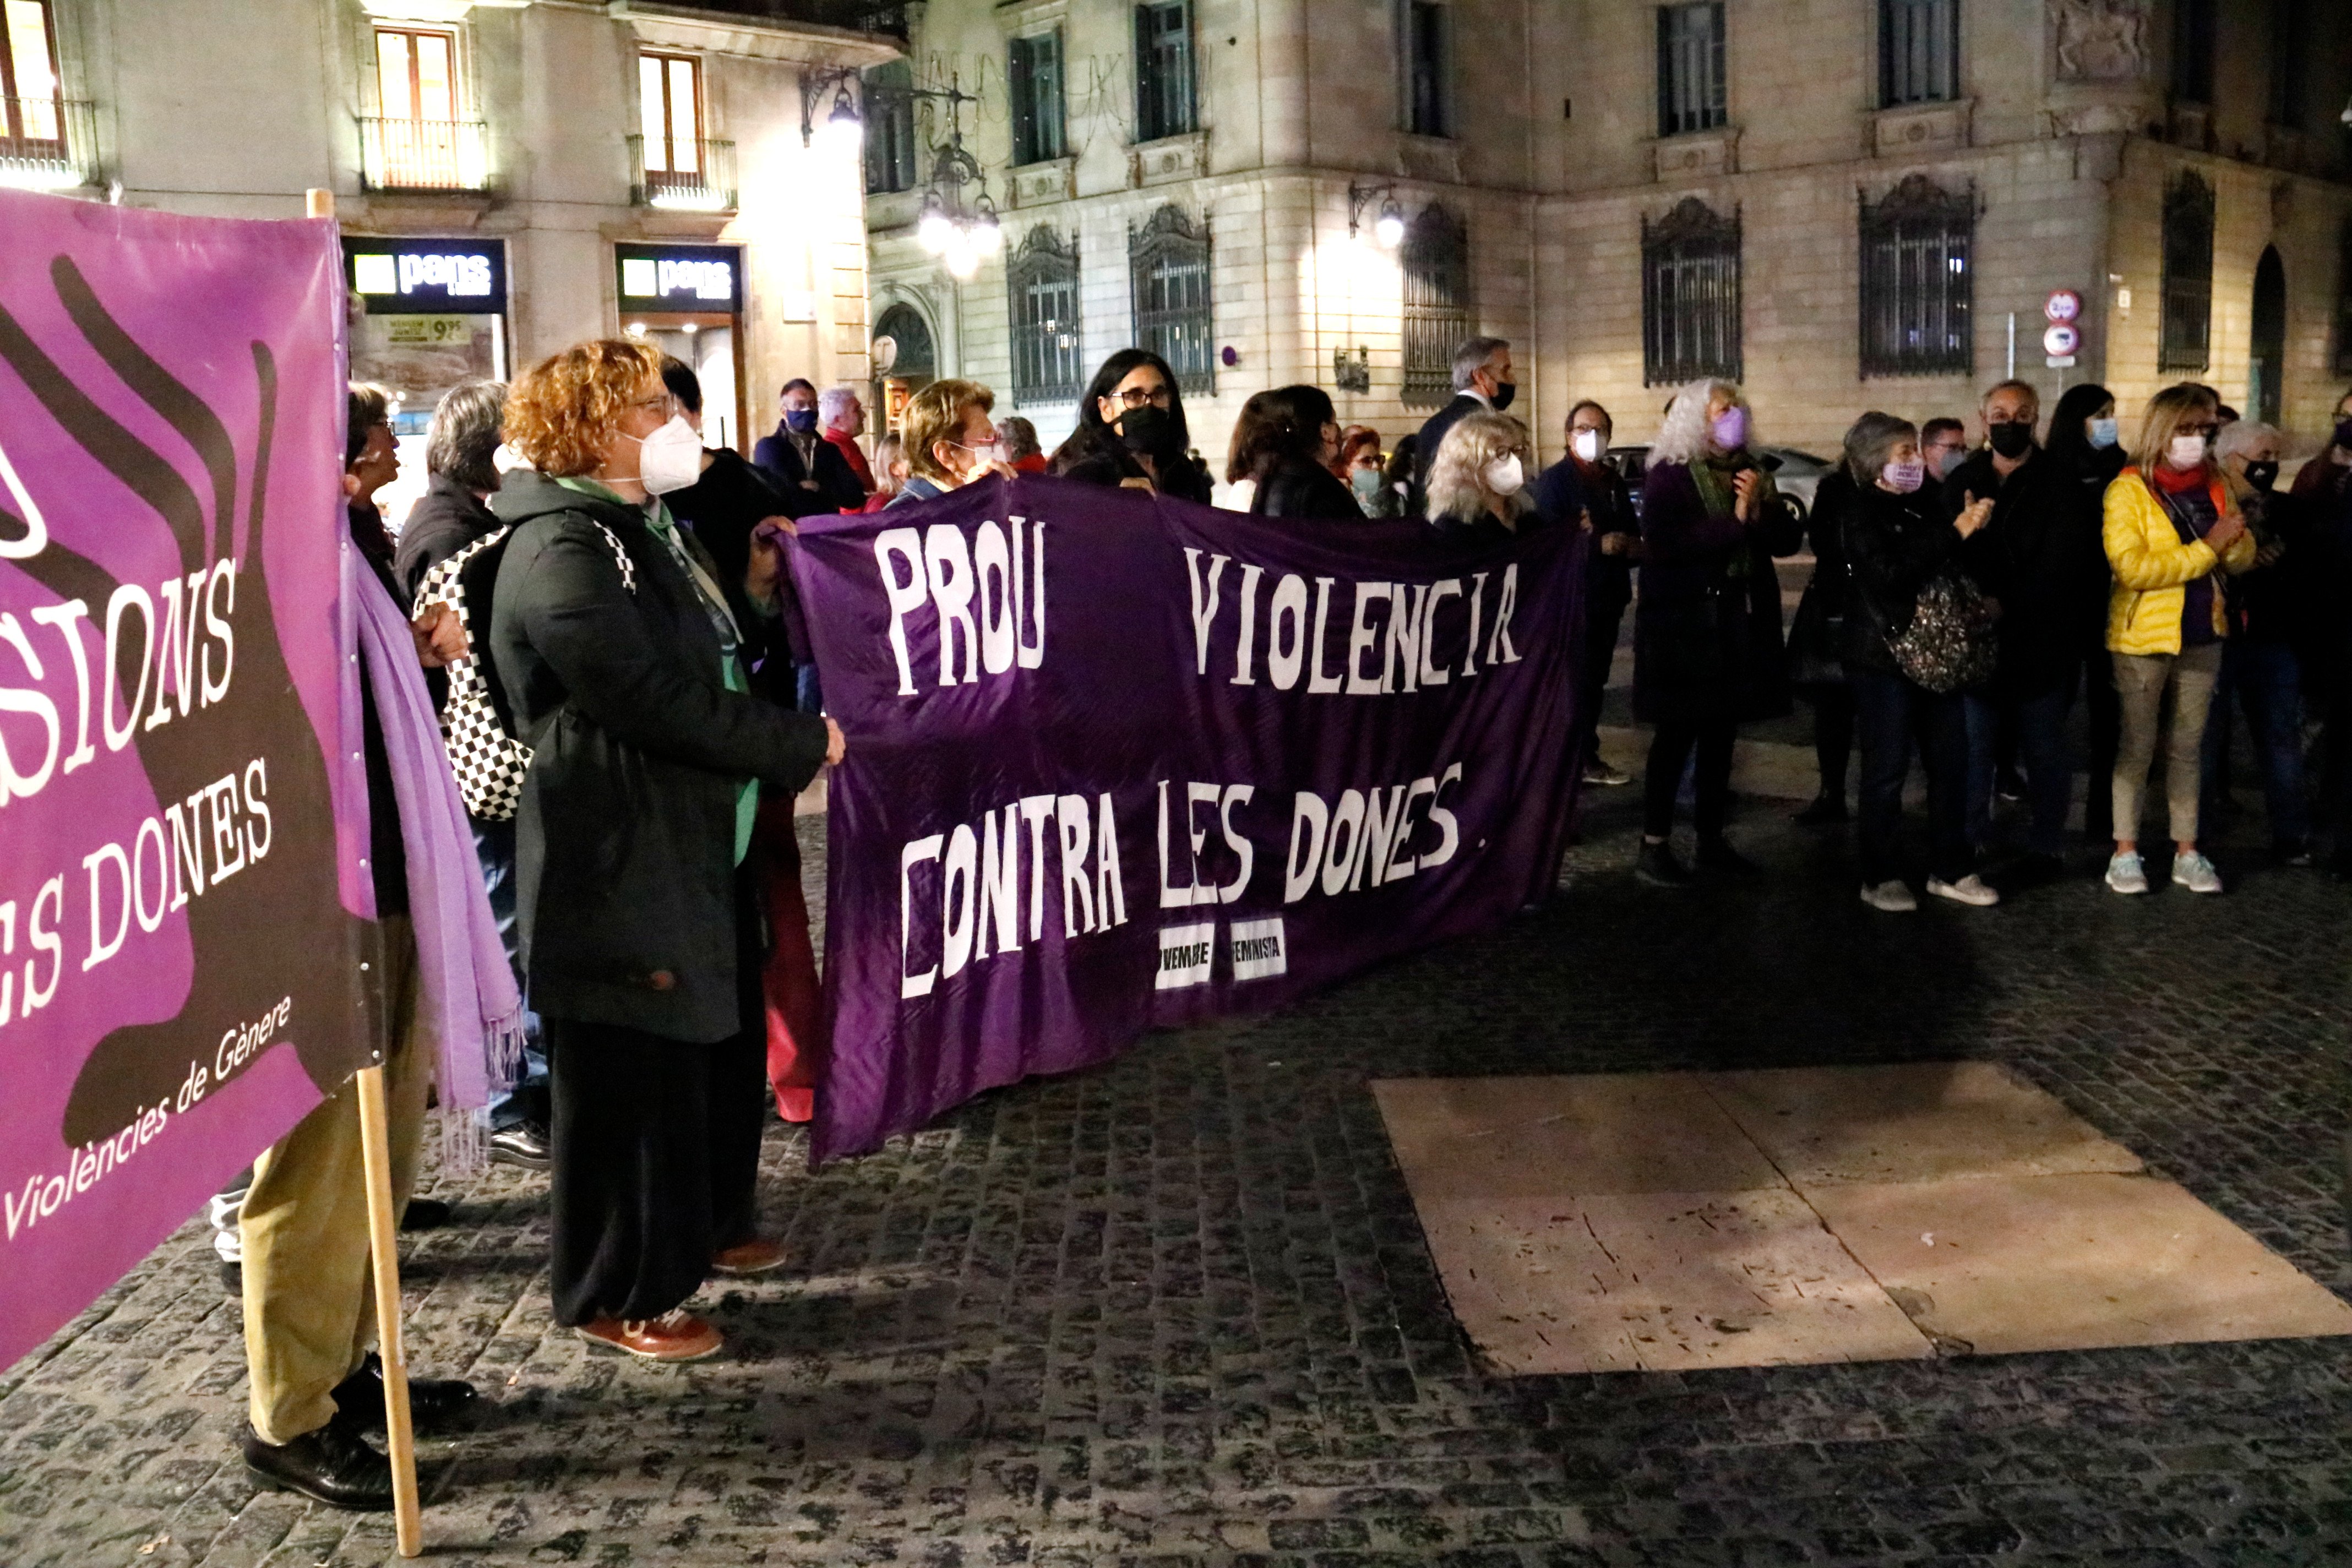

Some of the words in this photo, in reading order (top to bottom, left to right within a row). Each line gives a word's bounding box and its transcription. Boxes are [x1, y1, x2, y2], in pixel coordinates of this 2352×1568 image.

[874, 516, 1045, 695] PROU
[1184, 547, 1521, 694] VIOLENCIA
[82, 756, 271, 971] DONES
[902, 793, 1128, 999] CONTRA
[1158, 780, 1254, 908] LES
[1284, 763, 1461, 903] DONES
[5, 1097, 170, 1241] Violències
[177, 1060, 207, 1114] de
[215, 996, 291, 1080] Gènere
